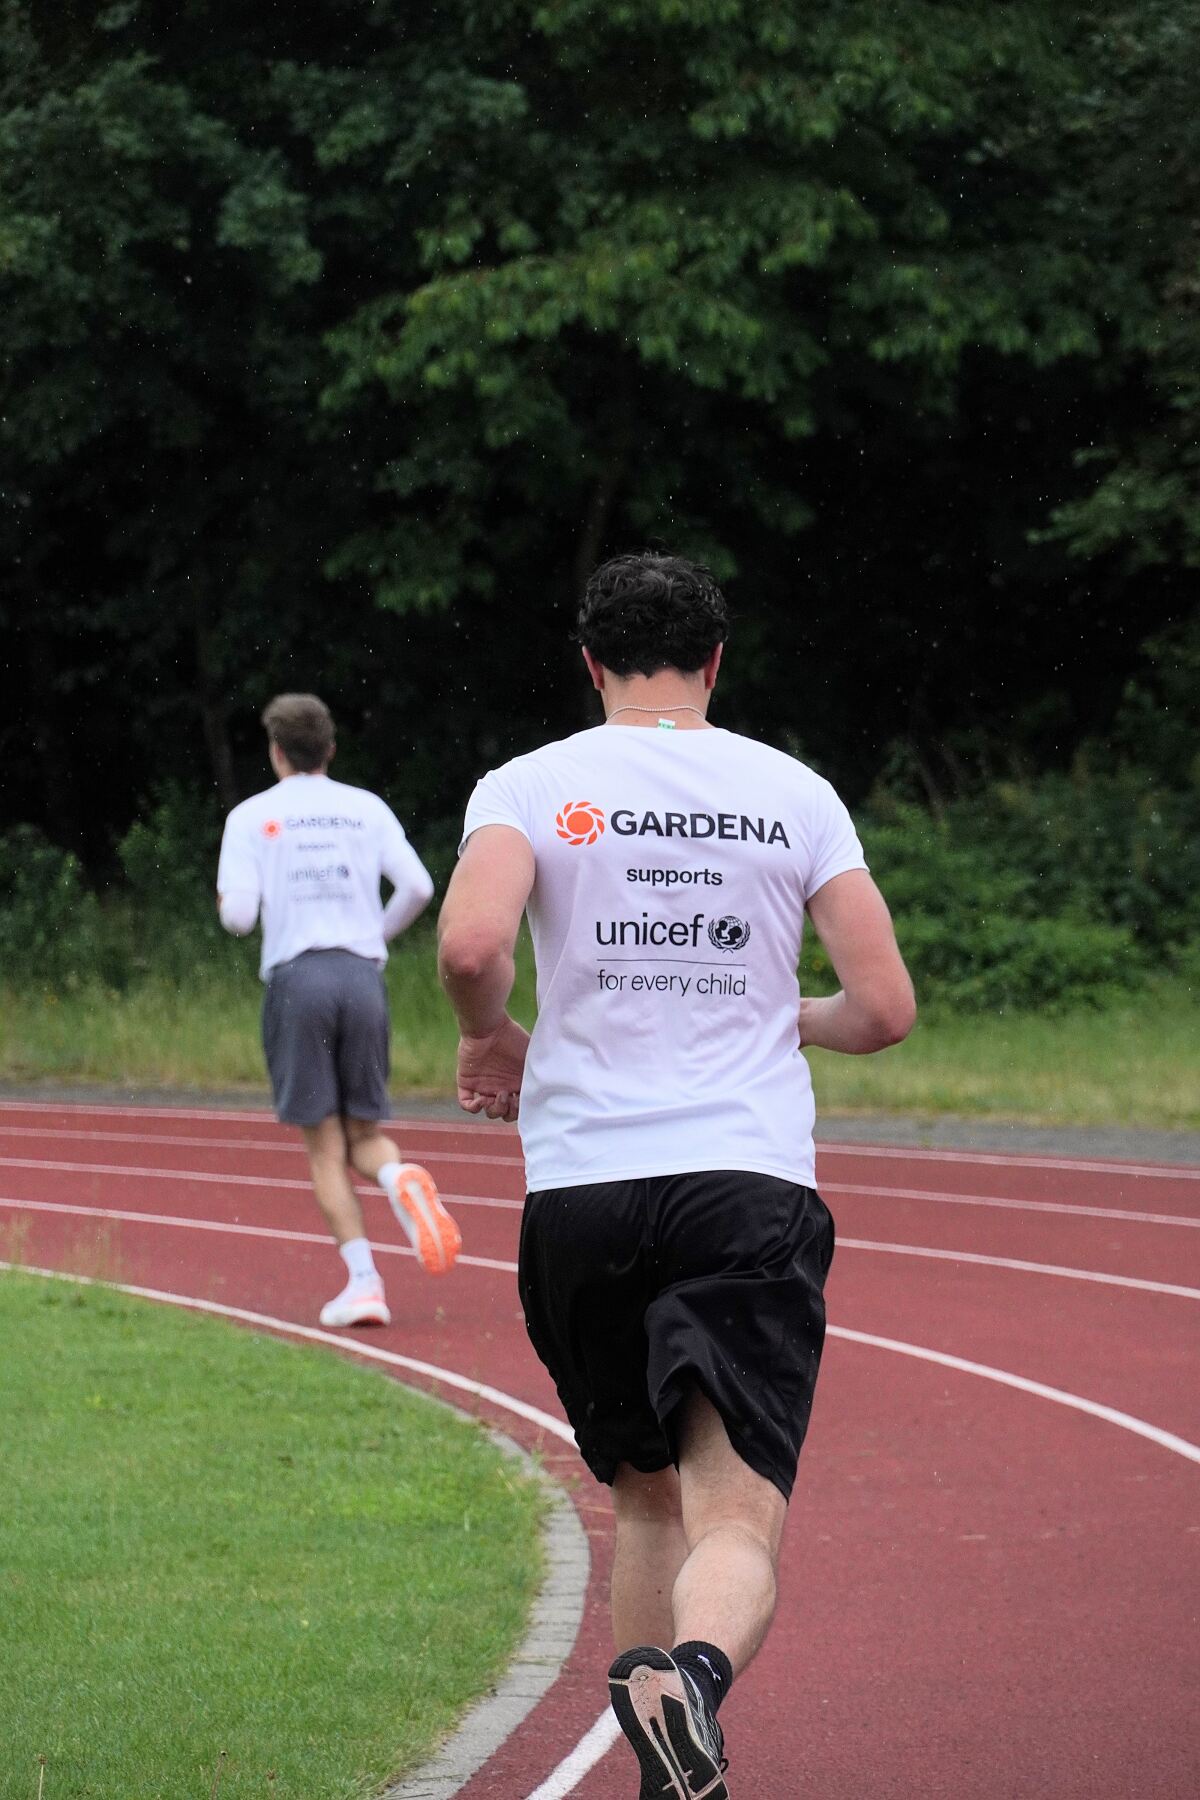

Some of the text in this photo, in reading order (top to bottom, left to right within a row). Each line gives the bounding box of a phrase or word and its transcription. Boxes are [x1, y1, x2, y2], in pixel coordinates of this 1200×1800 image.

[610, 809, 791, 849] GARDENA
[626, 868, 723, 887] supports
[596, 912, 705, 947] unicef
[597, 969, 747, 997] for every child
